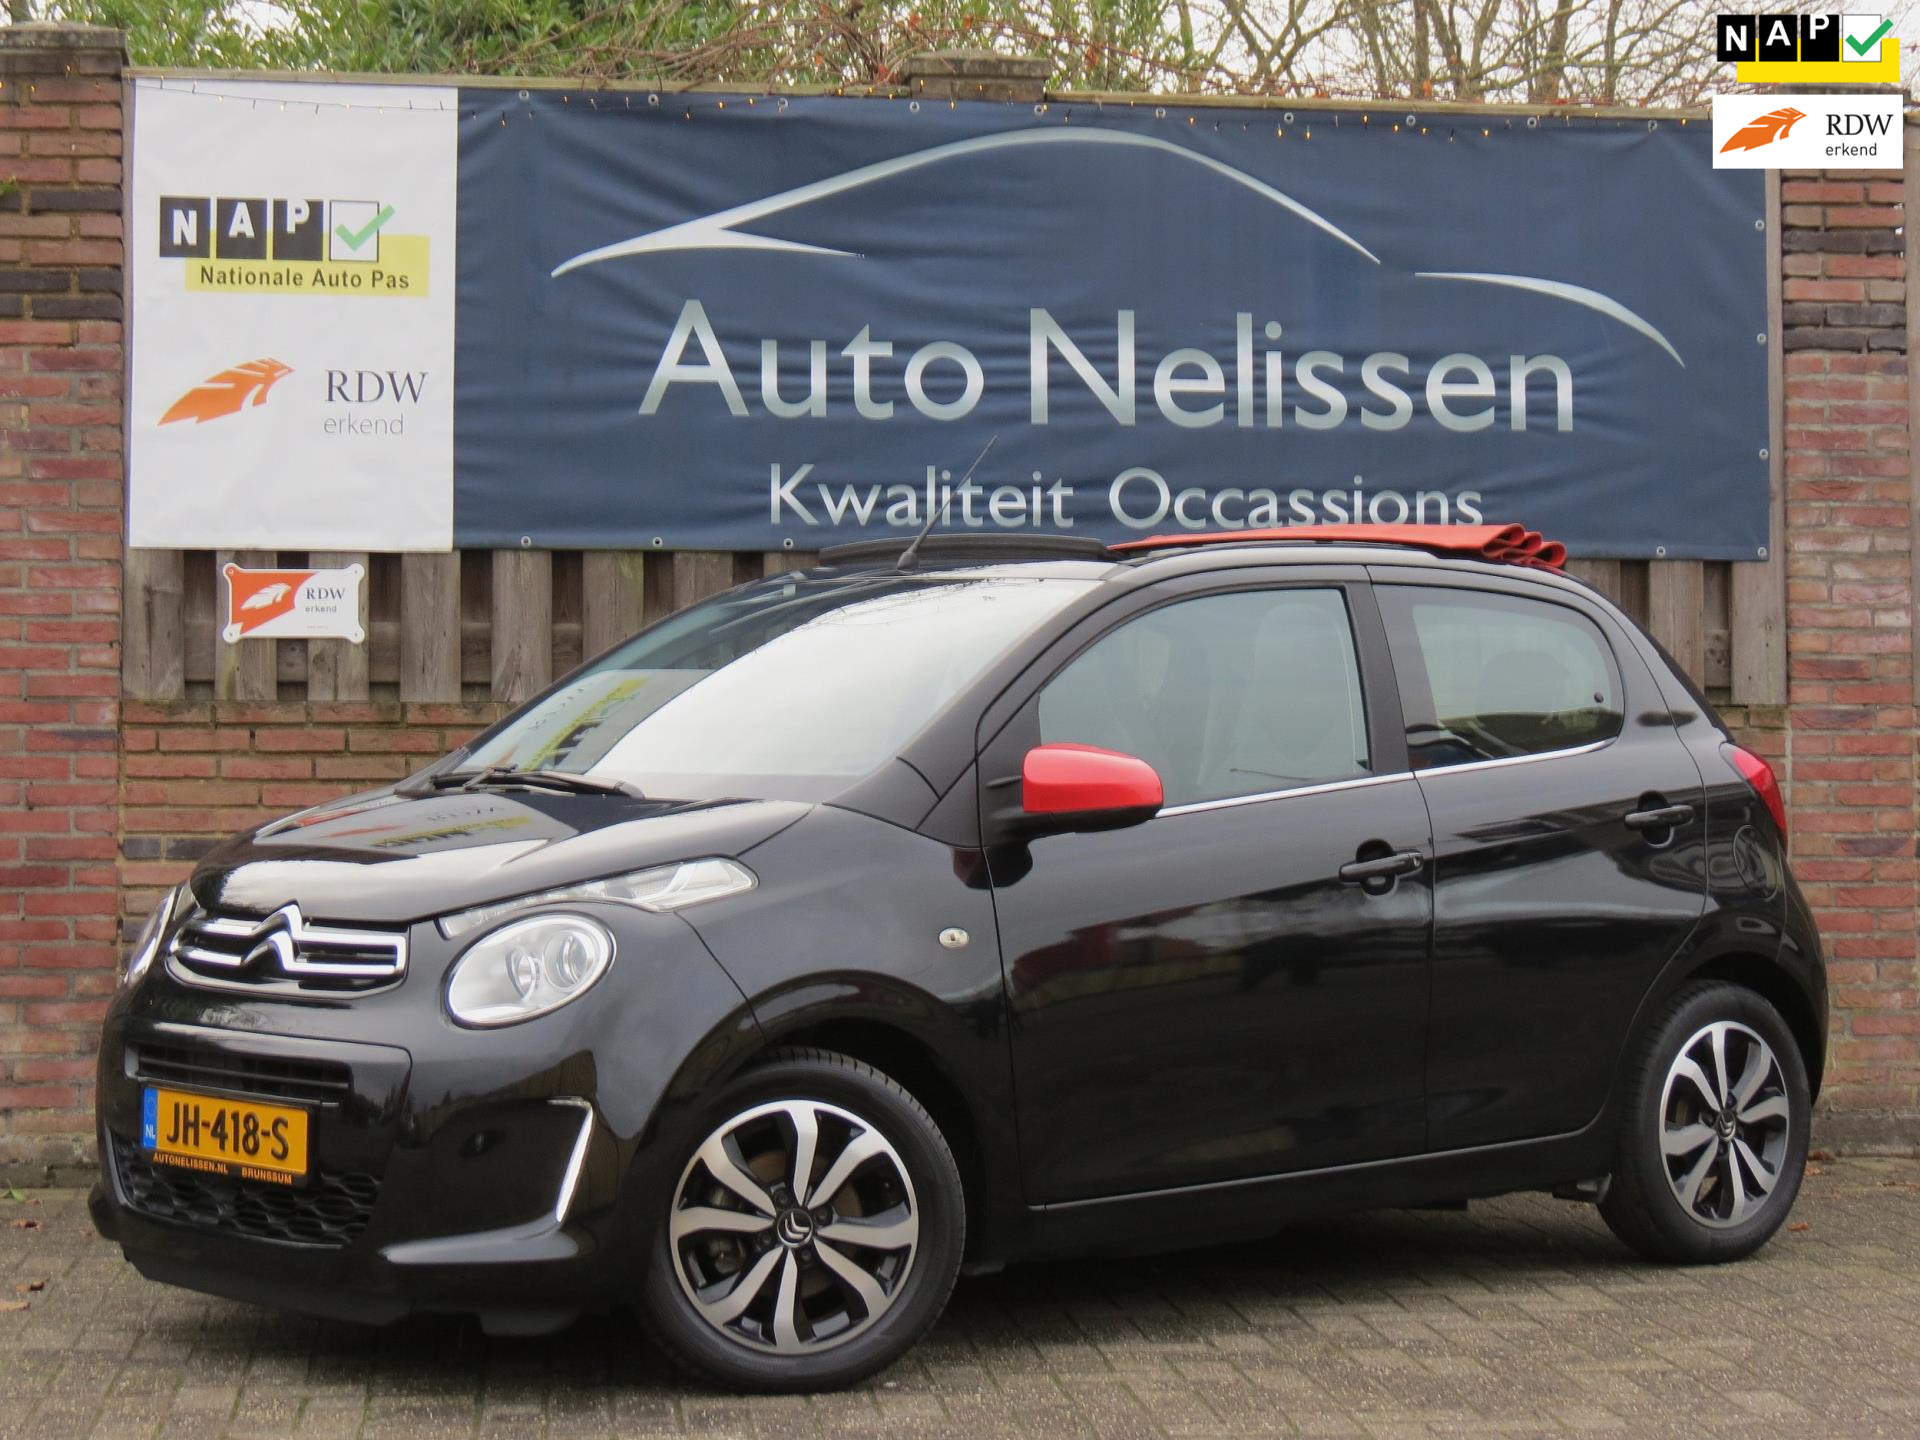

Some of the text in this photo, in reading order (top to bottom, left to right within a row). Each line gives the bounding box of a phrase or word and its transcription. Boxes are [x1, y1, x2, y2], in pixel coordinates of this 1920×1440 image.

[172, 198, 311, 247] NAP
[200, 265, 410, 290] Nationale Auto Pas
[638, 299, 1574, 433] Auto Nelissen
[324, 368, 429, 404] RDW
[323, 412, 404, 435] erkend
[770, 463, 1484, 529] Kwaliteit Occassions
[305, 587, 346, 600] RDW
[305, 604, 337, 613] erkend
[145, 1124, 156, 1138] NL
[166, 1101, 289, 1161] JH-418-S
[153, 1151, 293, 1185] AUTONELISSEN.NL BRUNSSUM
